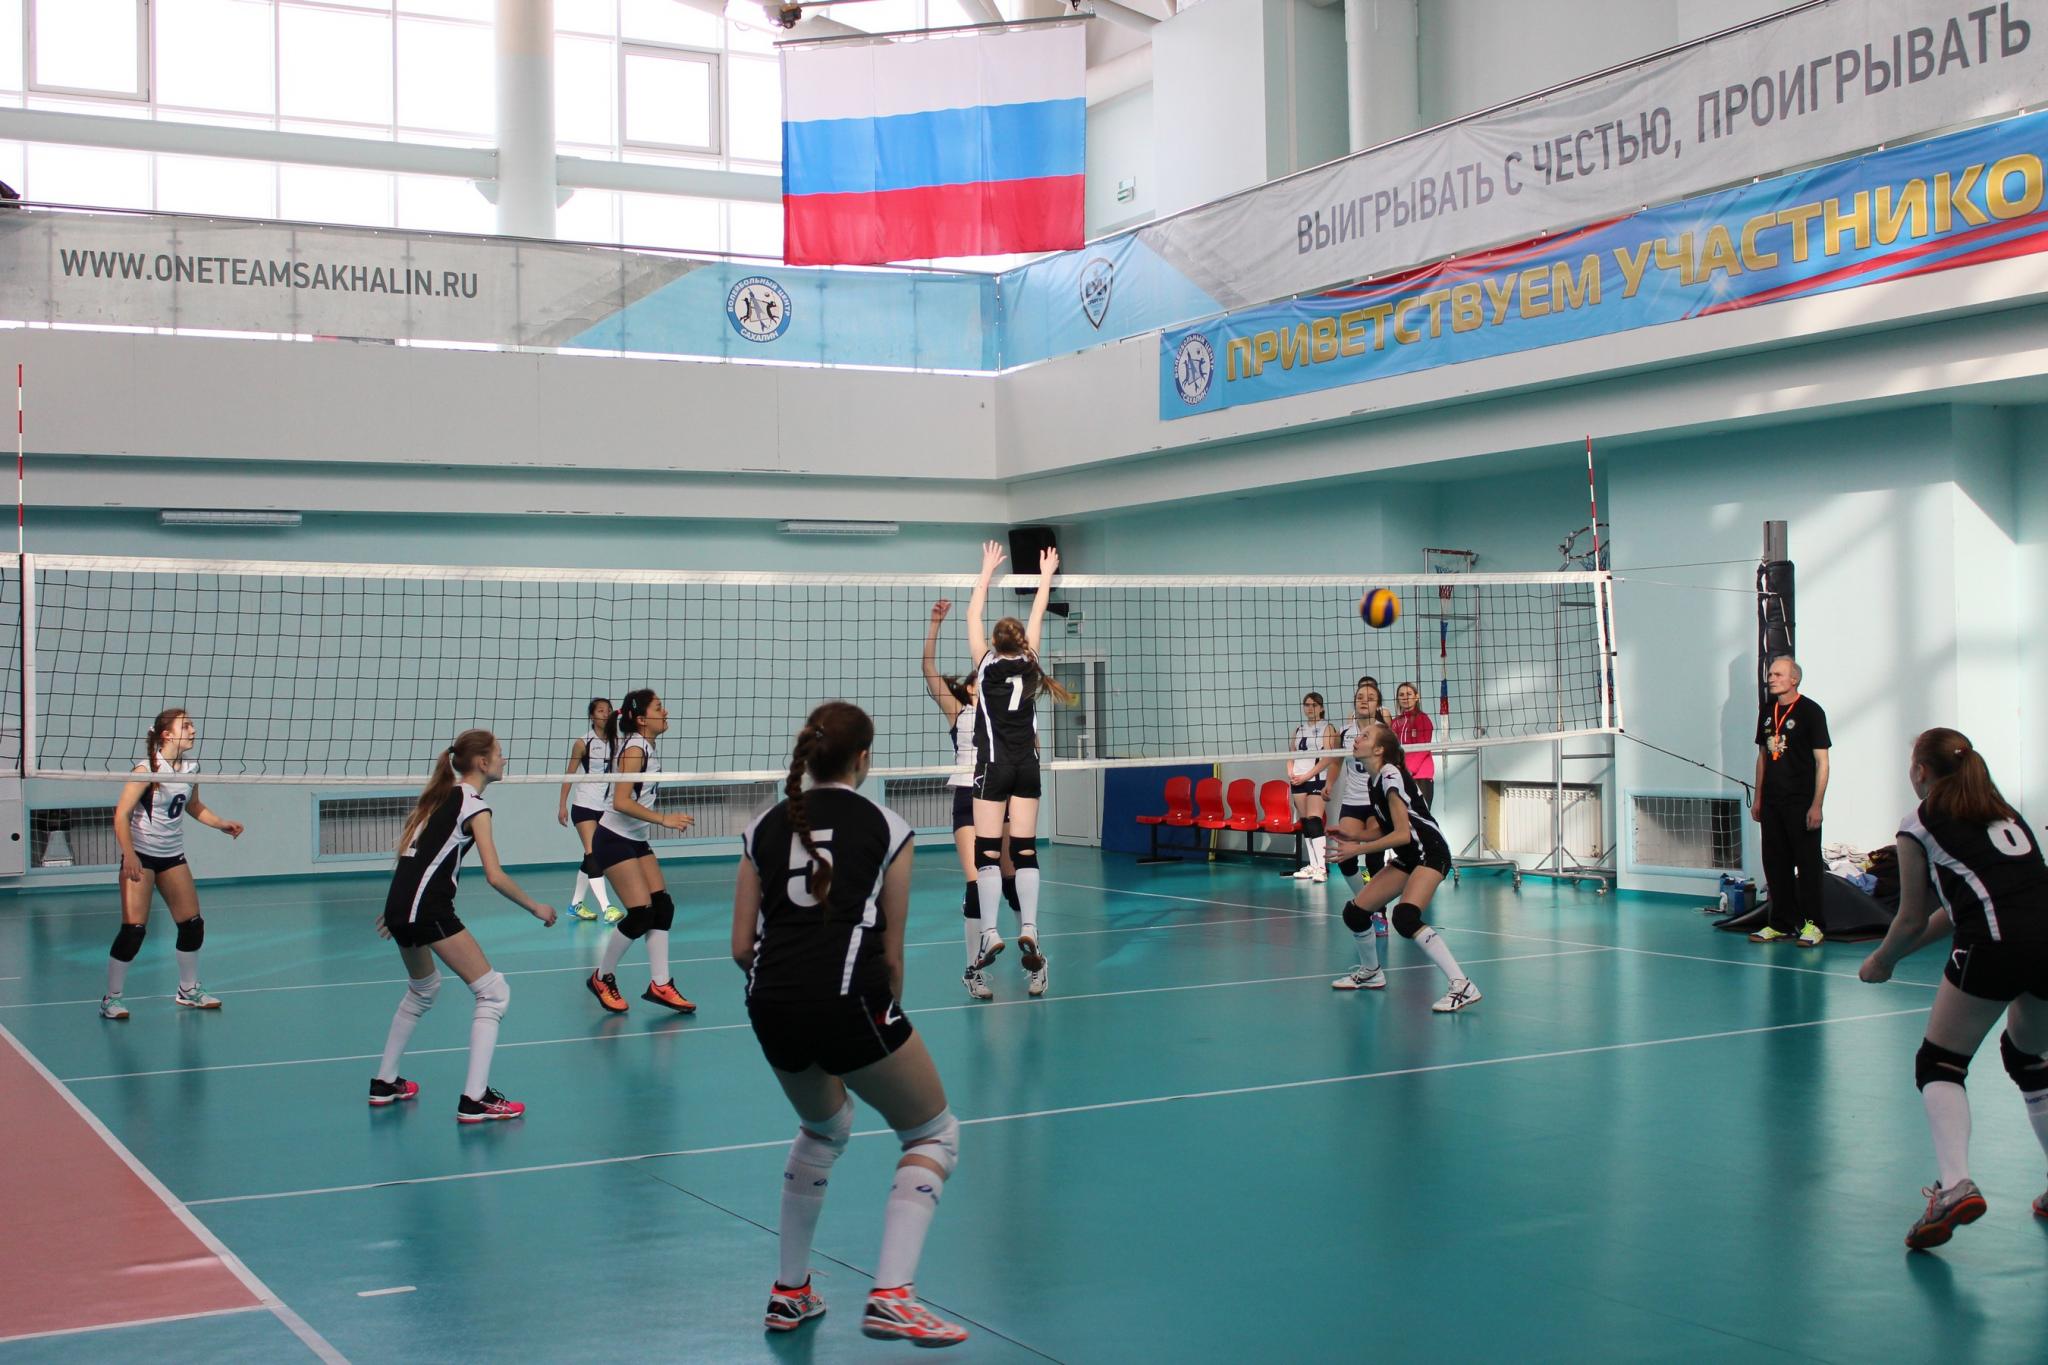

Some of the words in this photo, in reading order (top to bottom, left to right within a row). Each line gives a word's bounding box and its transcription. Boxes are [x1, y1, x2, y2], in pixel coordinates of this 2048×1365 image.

[1297, 162, 1494, 255] ВЫИГРЫВАТЬ
[1504, 151, 1523, 196] С
[1533, 106, 1682, 186] ЧЕСТЬЮ,
[1698, 2, 2031, 143] ПРОИГРЫВАТЬ
[60, 248, 478, 298] WWW.ONETEAMSAKHALIN.RU
[1226, 253, 1602, 382] ПРИВЕТСТВУЕМ
[1612, 152, 2045, 299] УЧАСТНИКО
[740, 328, 779, 341] САХАЛИН
[168, 794, 186, 819] 6
[787, 829, 833, 907] 5
